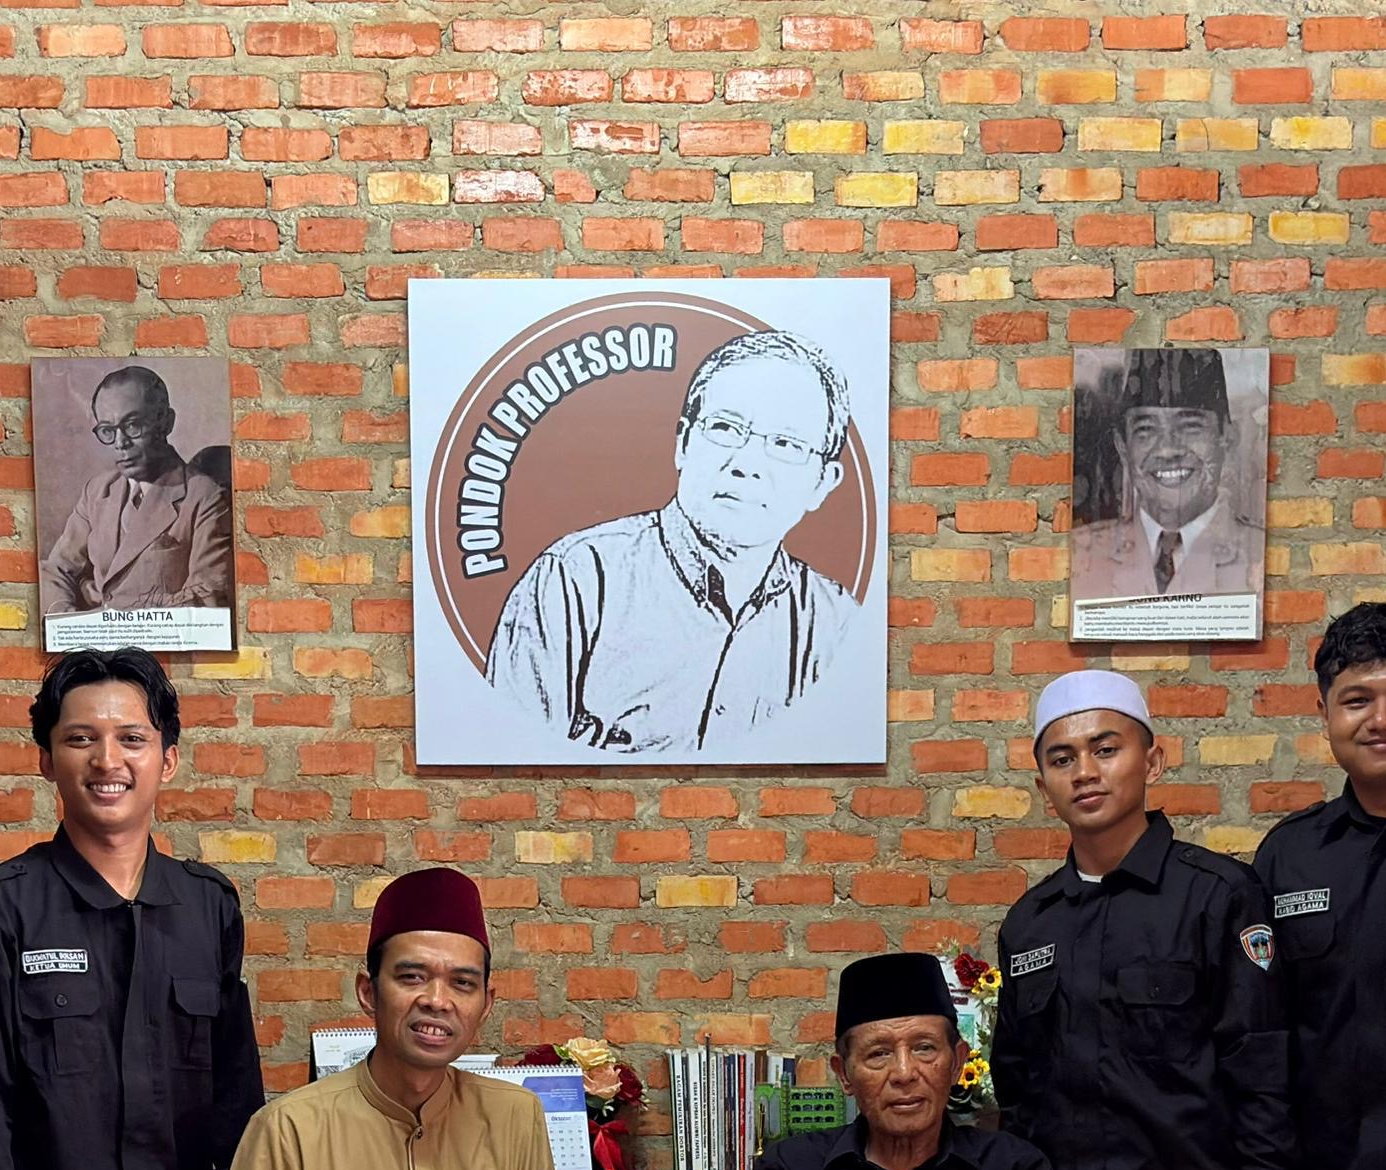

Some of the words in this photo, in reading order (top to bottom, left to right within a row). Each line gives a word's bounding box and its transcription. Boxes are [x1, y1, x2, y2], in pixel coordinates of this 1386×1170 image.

[458, 423, 519, 579] PONDOK
[490, 324, 676, 436] PROFESSOR
[102, 611, 134, 622] BUNG
[137, 611, 173, 621] HATTA
[1297, 901, 1324, 912] AGAMA
[1018, 959, 1047, 973] AGAMA
